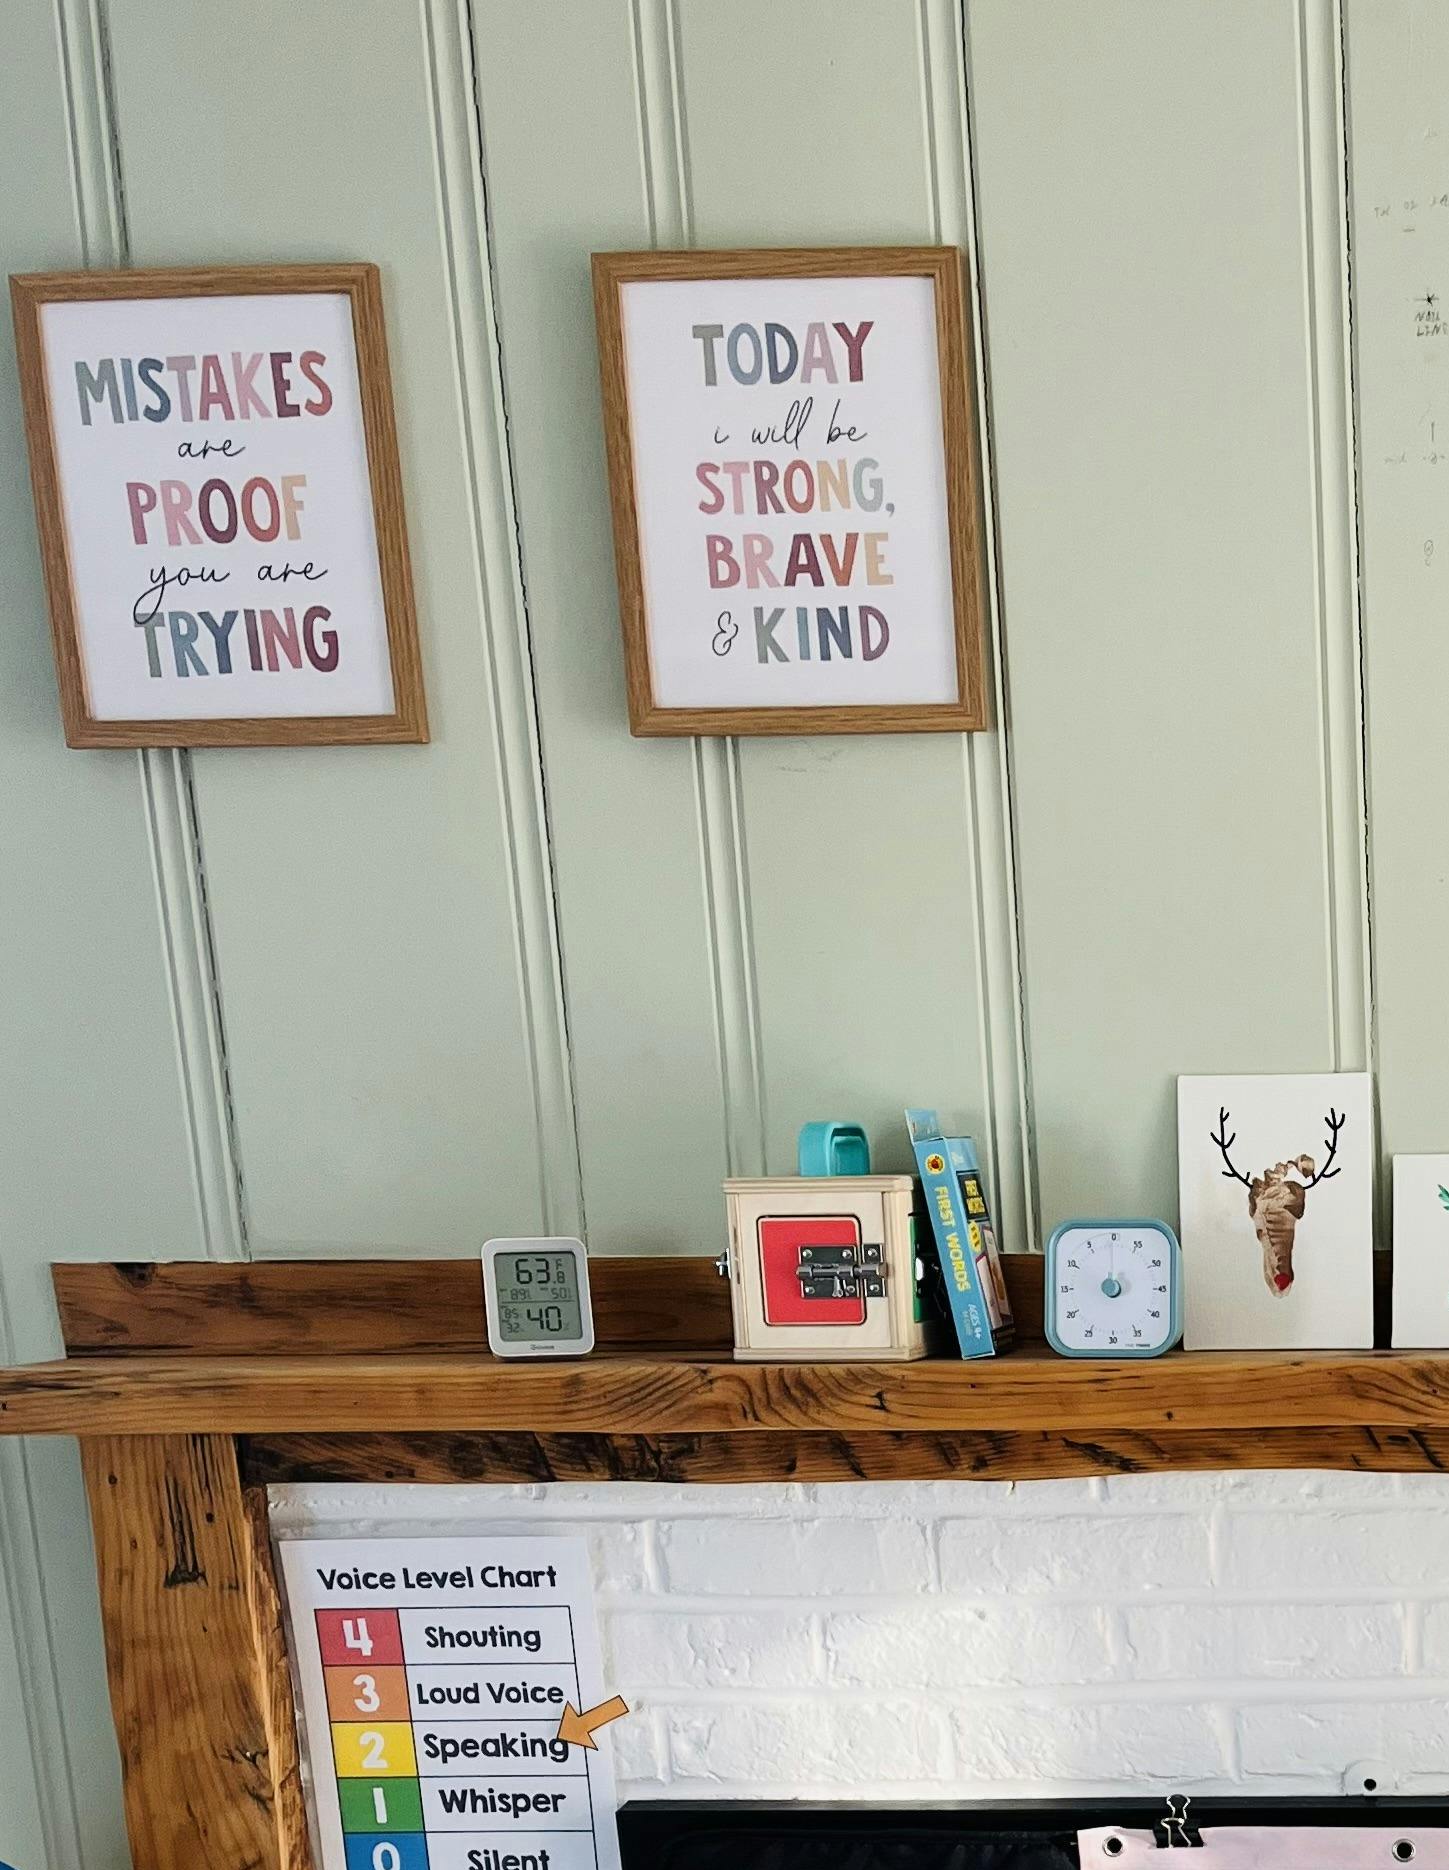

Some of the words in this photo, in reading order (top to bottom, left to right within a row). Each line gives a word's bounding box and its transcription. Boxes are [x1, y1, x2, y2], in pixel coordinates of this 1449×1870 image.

[692, 320, 875, 387] TODAY
[74, 350, 334, 426] MISTAKES
[714, 425, 730, 445] i
[751, 396, 814, 451] will
[826, 398, 868, 448] be
[177, 437, 247, 459] are
[695, 456, 896, 518] STRONG,
[125, 474, 308, 546] PROOF
[705, 532, 895, 589] BRAVE
[132, 564, 231, 625] you
[257, 561, 329, 582] are
[134, 605, 340, 679] TRYING
[711, 610, 739, 656] &
[753, 604, 890, 664] KIND
[934, 1186, 957, 1228] FIRST
[946, 1231, 972, 1292] WORDS
[1111, 1233, 1117, 1241] 0
[1061, 1285, 1069, 1293] 15
[1158, 1285, 1167, 1293] 45
[527, 1306, 562, 1331] 40
[1066, 1311, 1076, 1319] 20
[1109, 1337, 1118, 1345] 30
[317, 1567, 396, 1591] Voice
[402, 1565, 474, 1590] Level
[481, 1565, 557, 1588] Chart
[342, 1617, 374, 1657] 4
[426, 1625, 542, 1652] Shouting
[352, 1674, 380, 1712] 3
[416, 1683, 479, 1705] Loud
[486, 1681, 564, 1704] Voice
[359, 1731, 388, 1769] 2
[423, 1732, 570, 1764] Speaking
[372, 1786, 388, 1824] 1
[438, 1788, 567, 1819] Whisper
